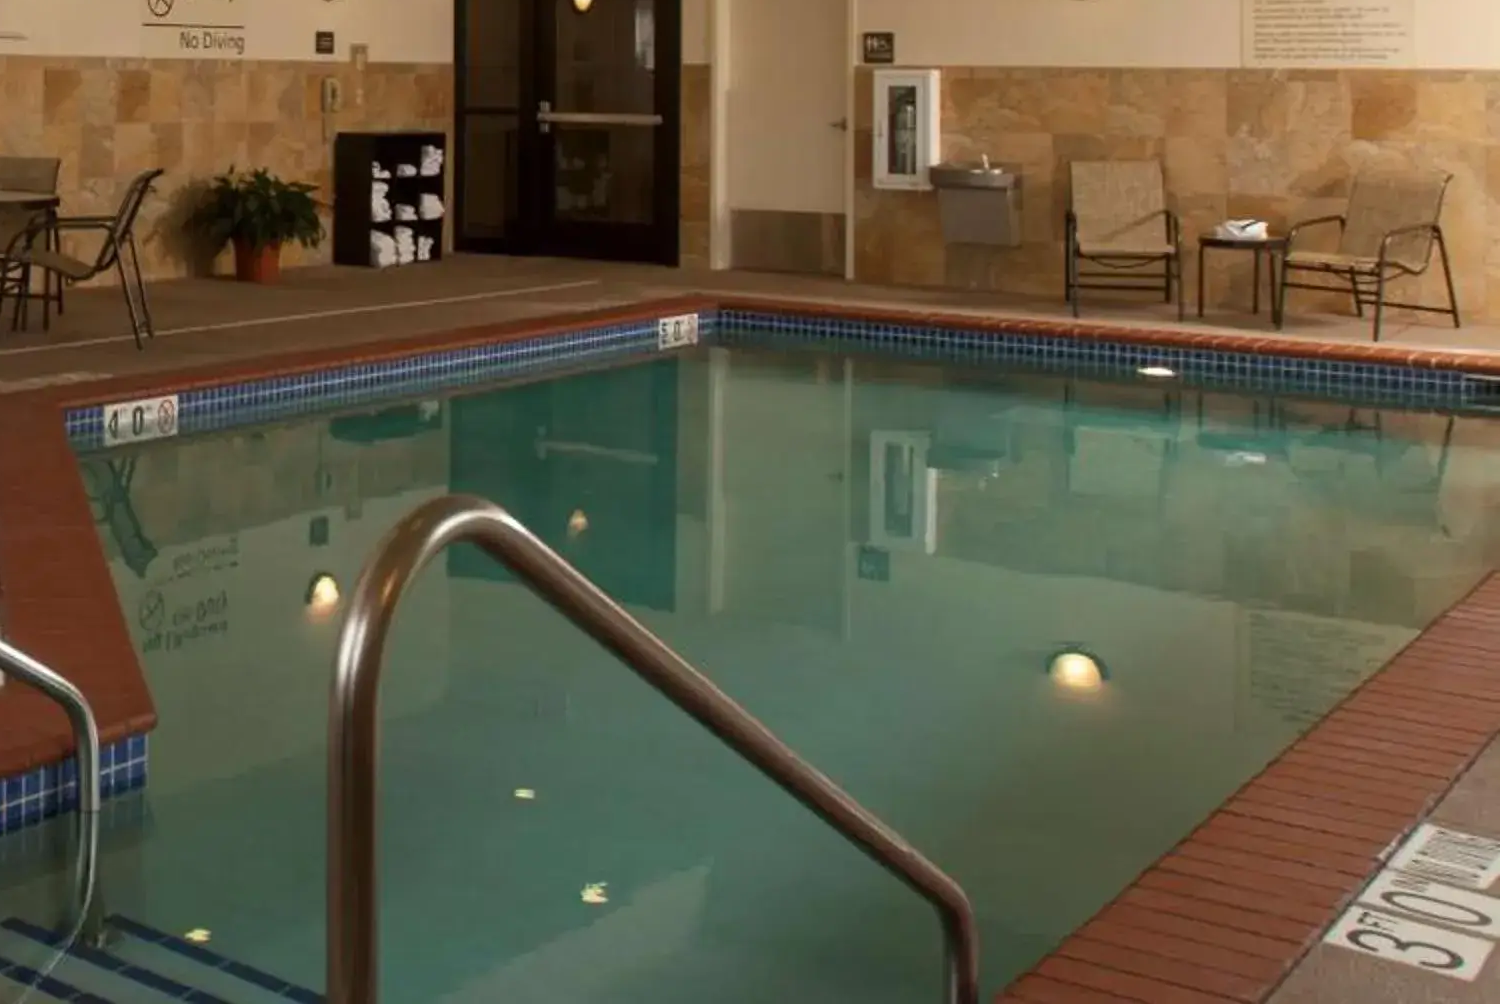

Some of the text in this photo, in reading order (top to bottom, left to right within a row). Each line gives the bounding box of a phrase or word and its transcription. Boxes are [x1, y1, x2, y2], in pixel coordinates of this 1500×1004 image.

[180, 31, 245, 55] No Diving
[1346, 928, 1465, 970] 3
